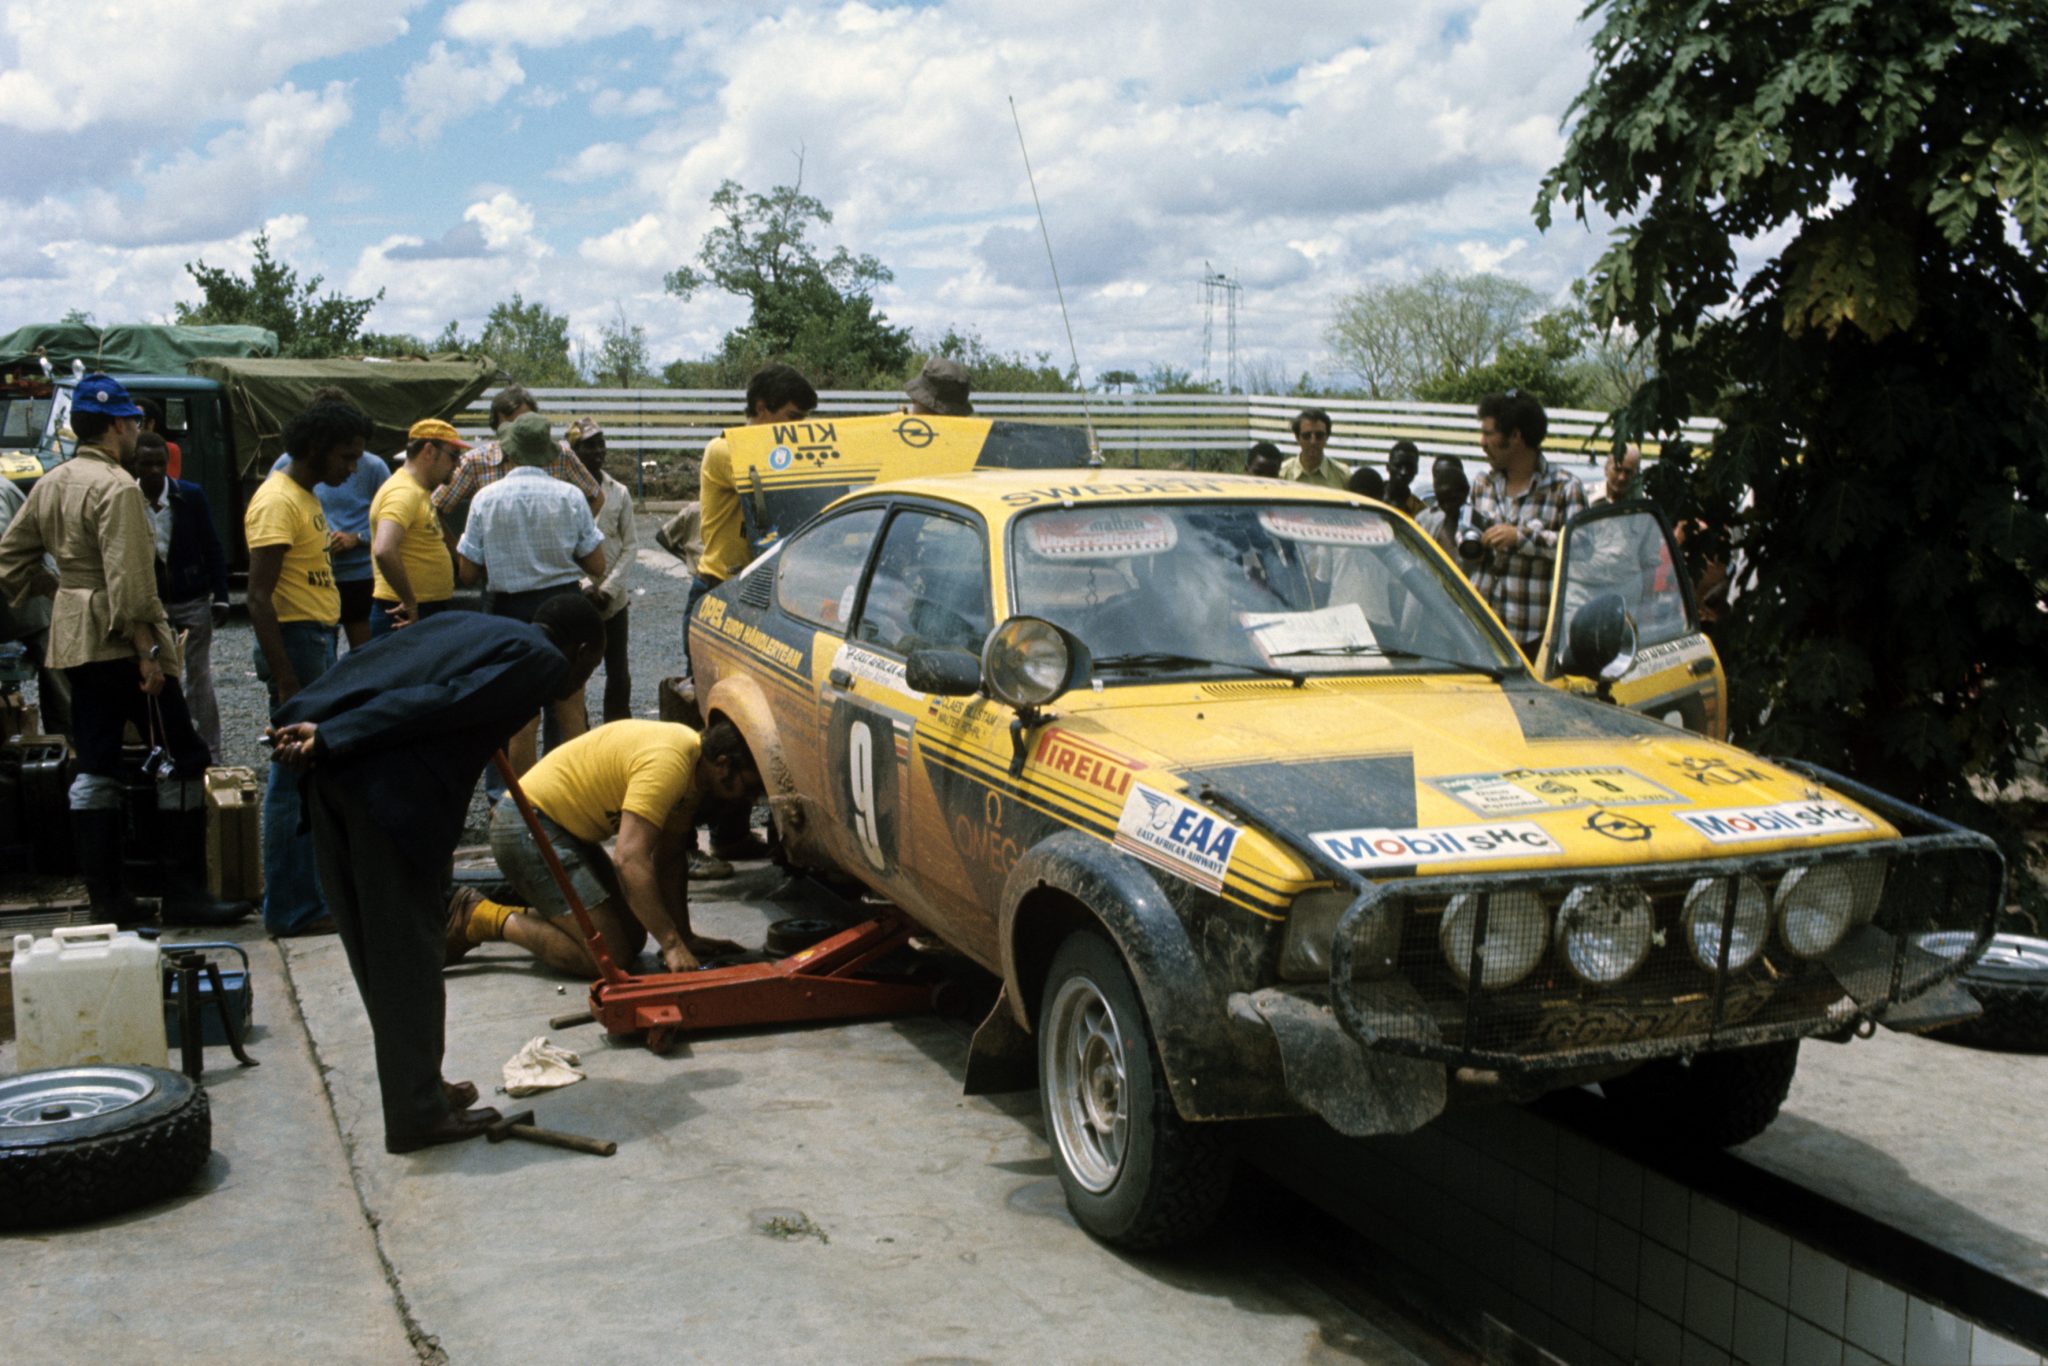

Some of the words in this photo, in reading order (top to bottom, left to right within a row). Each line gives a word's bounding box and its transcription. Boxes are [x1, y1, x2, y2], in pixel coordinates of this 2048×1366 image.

[772, 423, 837, 444] KLM
[697, 594, 728, 630] OPEL
[722, 616, 745, 640] EURO
[1034, 726, 1149, 796] PIRELLI
[1681, 767, 1775, 786] KLM
[849, 719, 886, 871] 9
[955, 814, 1031, 875] OMEG
[1168, 806, 1239, 864] EAA
[1686, 809, 1802, 836] Mobil
[1135, 826, 1157, 845] EAST
[1154, 834, 1188, 860] AFRICAN
[1186, 849, 1225, 875] AIRWAYS
[1323, 832, 1466, 861] Mobil
